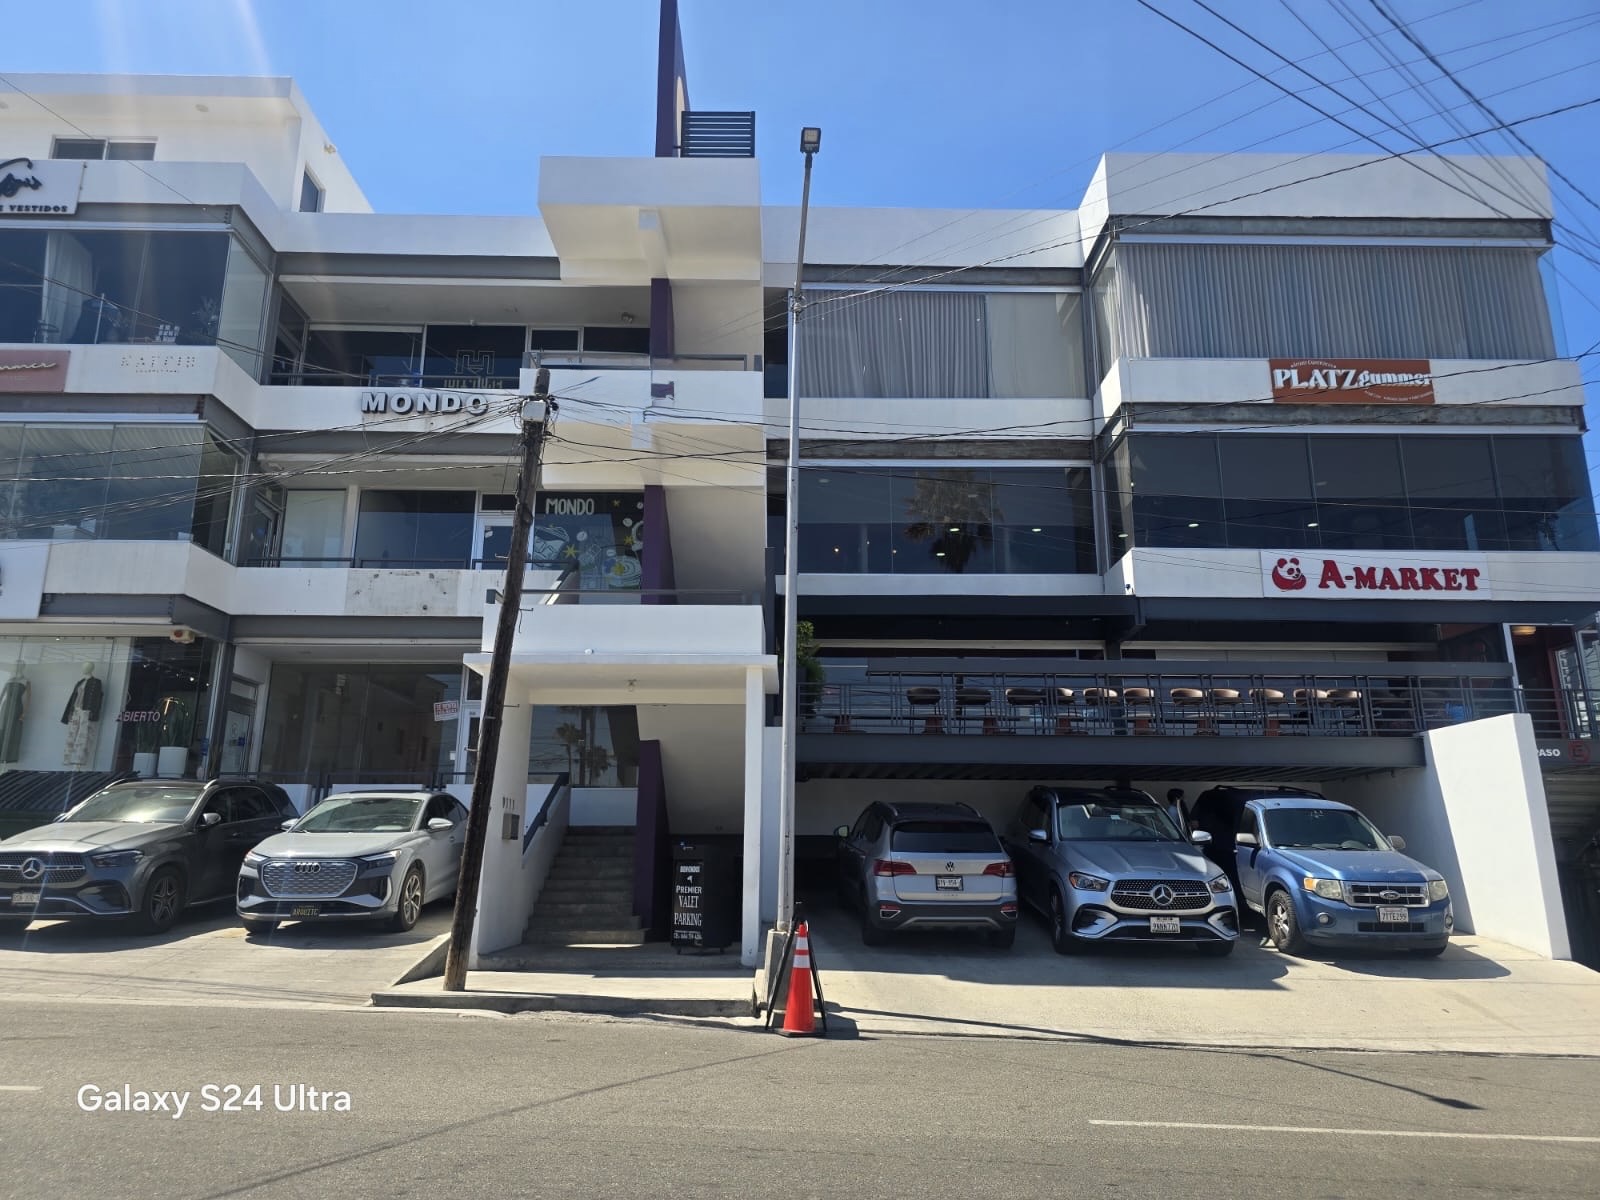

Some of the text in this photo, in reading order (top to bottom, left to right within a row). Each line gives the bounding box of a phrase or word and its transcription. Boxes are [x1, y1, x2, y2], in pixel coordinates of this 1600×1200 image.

[361, 392, 489, 415] MONDO
[545, 498, 595, 515] MONDO
[1318, 560, 1481, 591] A-MARKET
[115, 711, 161, 722] ABIERTO
[675, 885, 702, 894] PREMIER
[679, 895, 699, 909] VALET
[674, 912, 702, 927] PARKING
